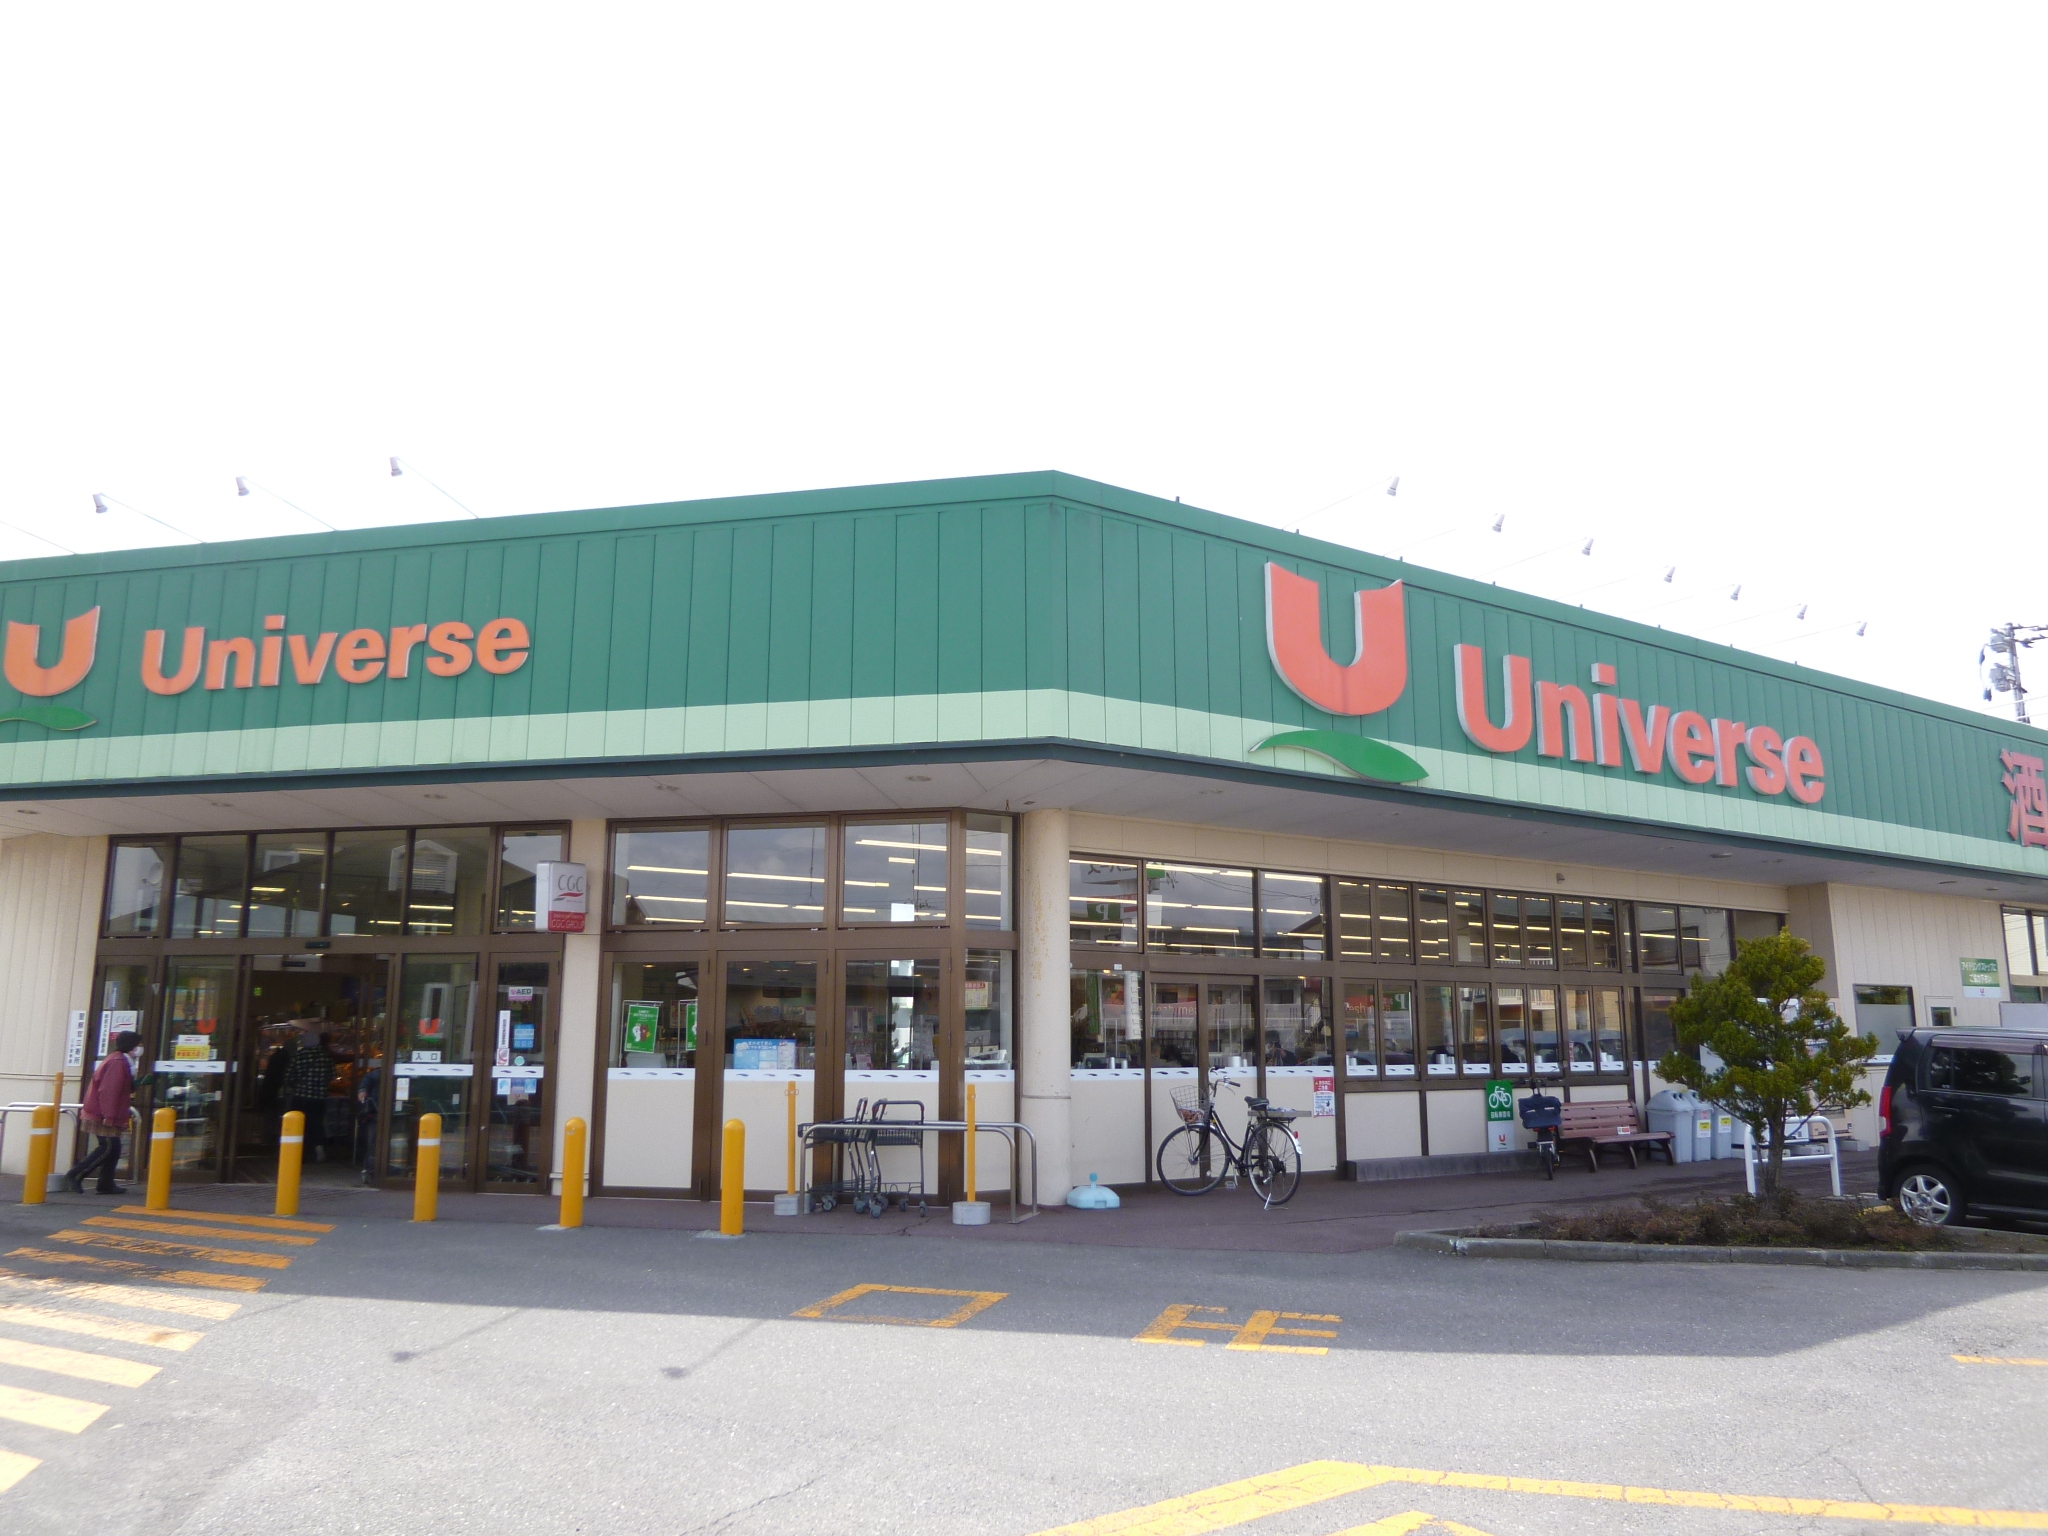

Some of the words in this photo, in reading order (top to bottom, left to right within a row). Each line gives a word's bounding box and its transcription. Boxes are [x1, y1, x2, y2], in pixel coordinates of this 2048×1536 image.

[141, 614, 530, 696] Universe
[1453, 643, 1826, 804] Universe
[1999, 748, 2048, 850] 酒
[557, 874, 584, 892] CGC
[414, 1052, 438, 1061] 入口
